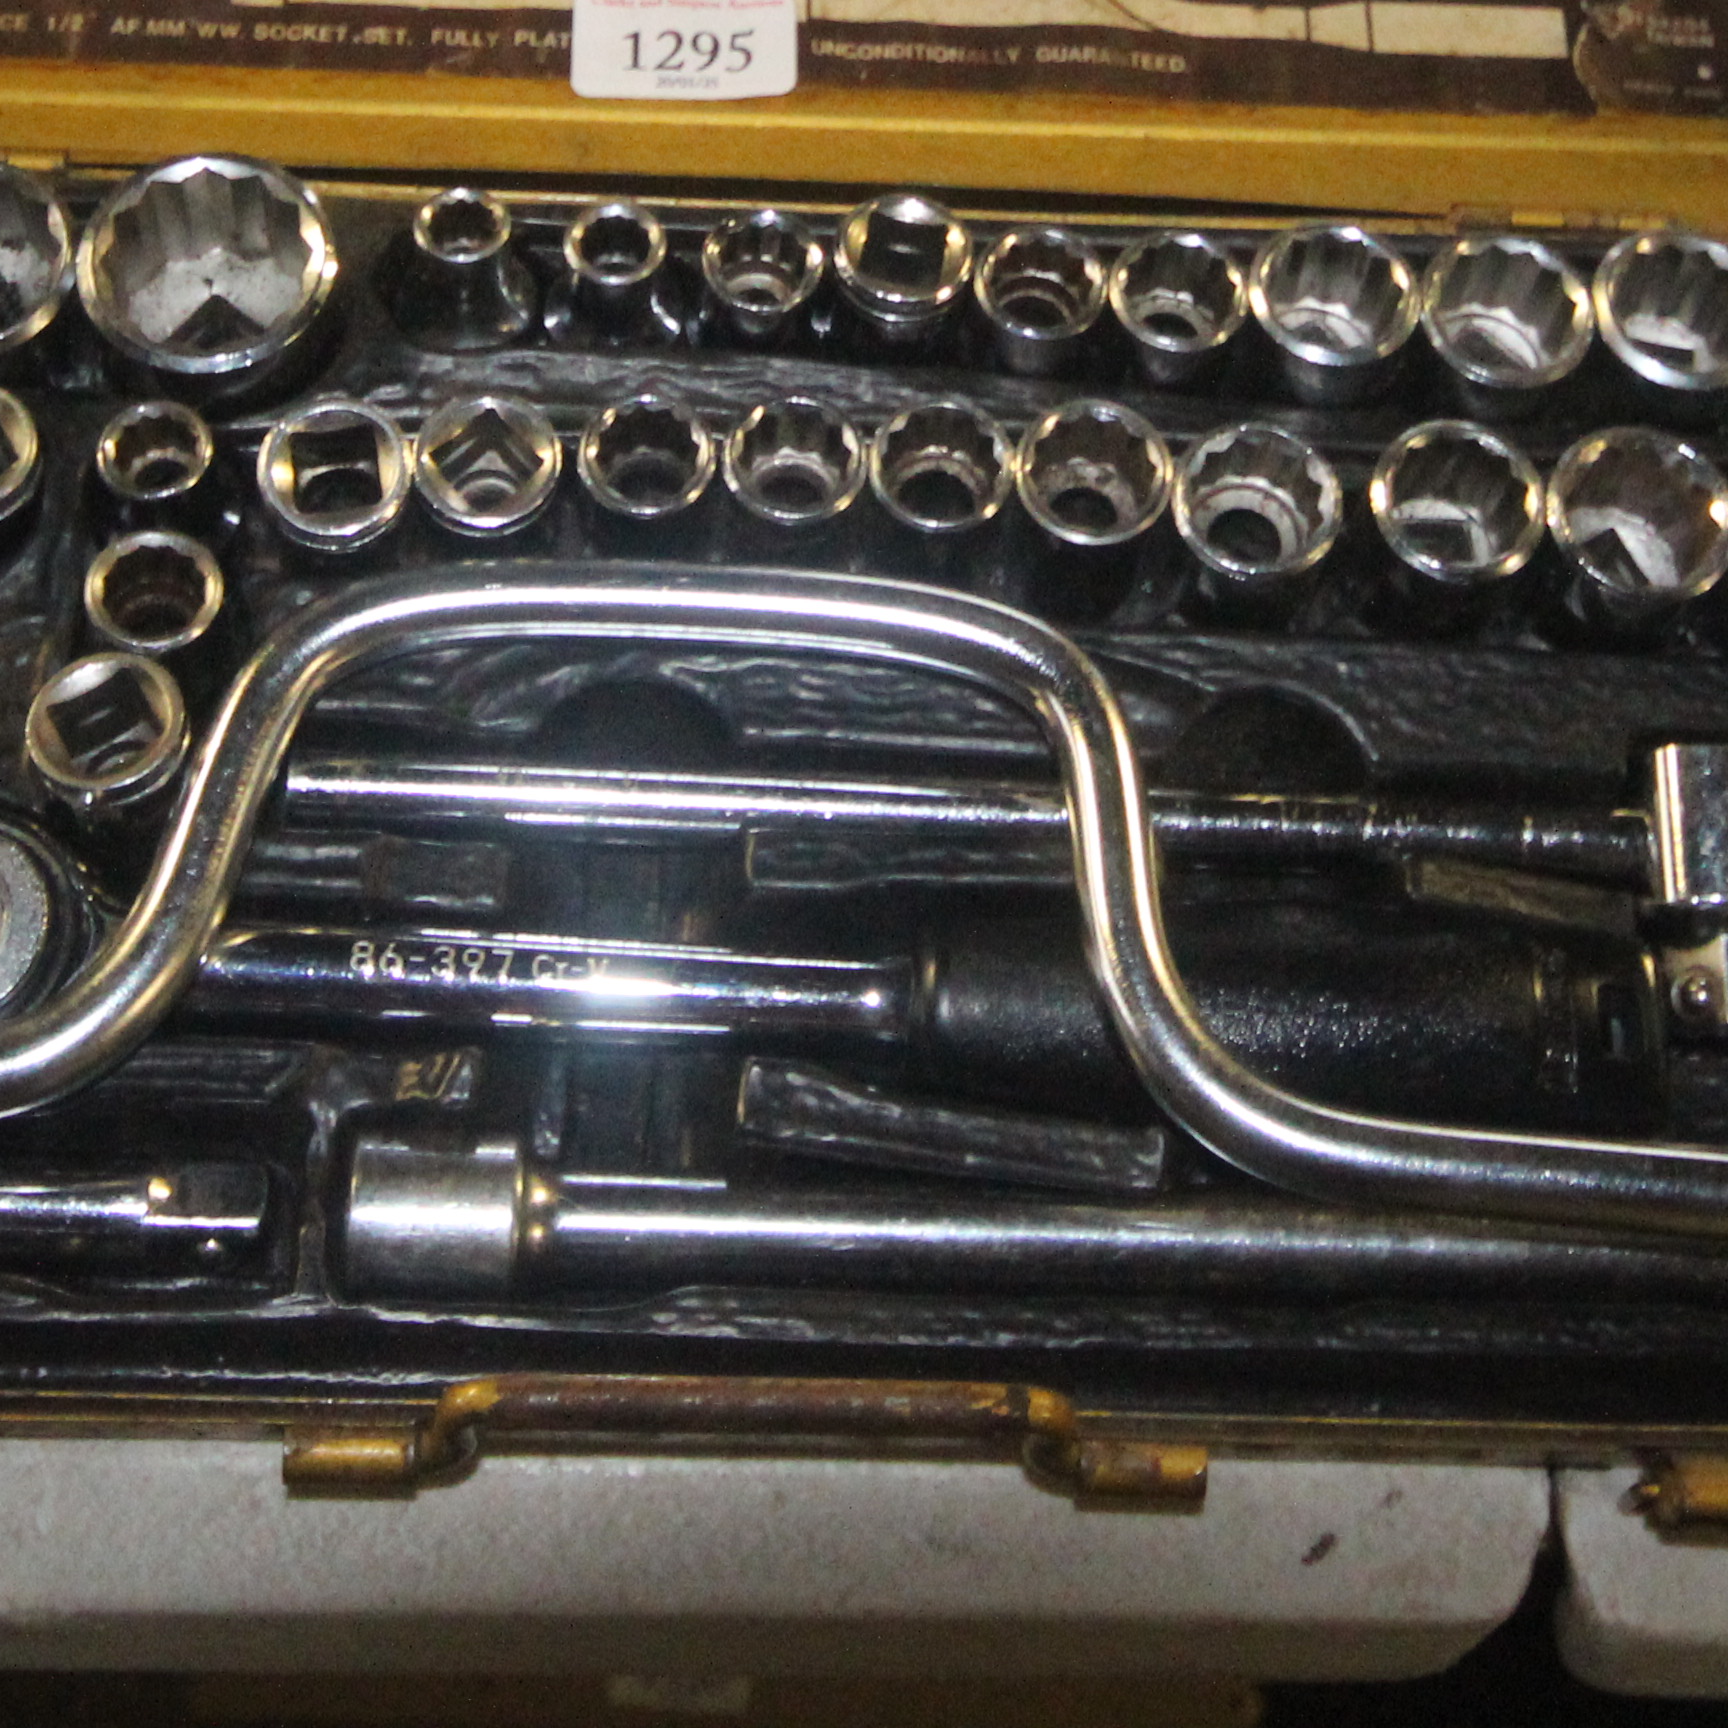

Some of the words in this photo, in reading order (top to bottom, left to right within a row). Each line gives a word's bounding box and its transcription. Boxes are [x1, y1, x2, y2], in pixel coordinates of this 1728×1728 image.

[253, 23, 347, 44] SOCKET
[431, 29, 500, 49] FULLY
[811, 39, 1020, 65] UNCONDITIONALLY
[1035, 46, 1186, 73] GUARATEED
[623, 28, 755, 72] 1295
[349, 940, 514, 981] 86-397
